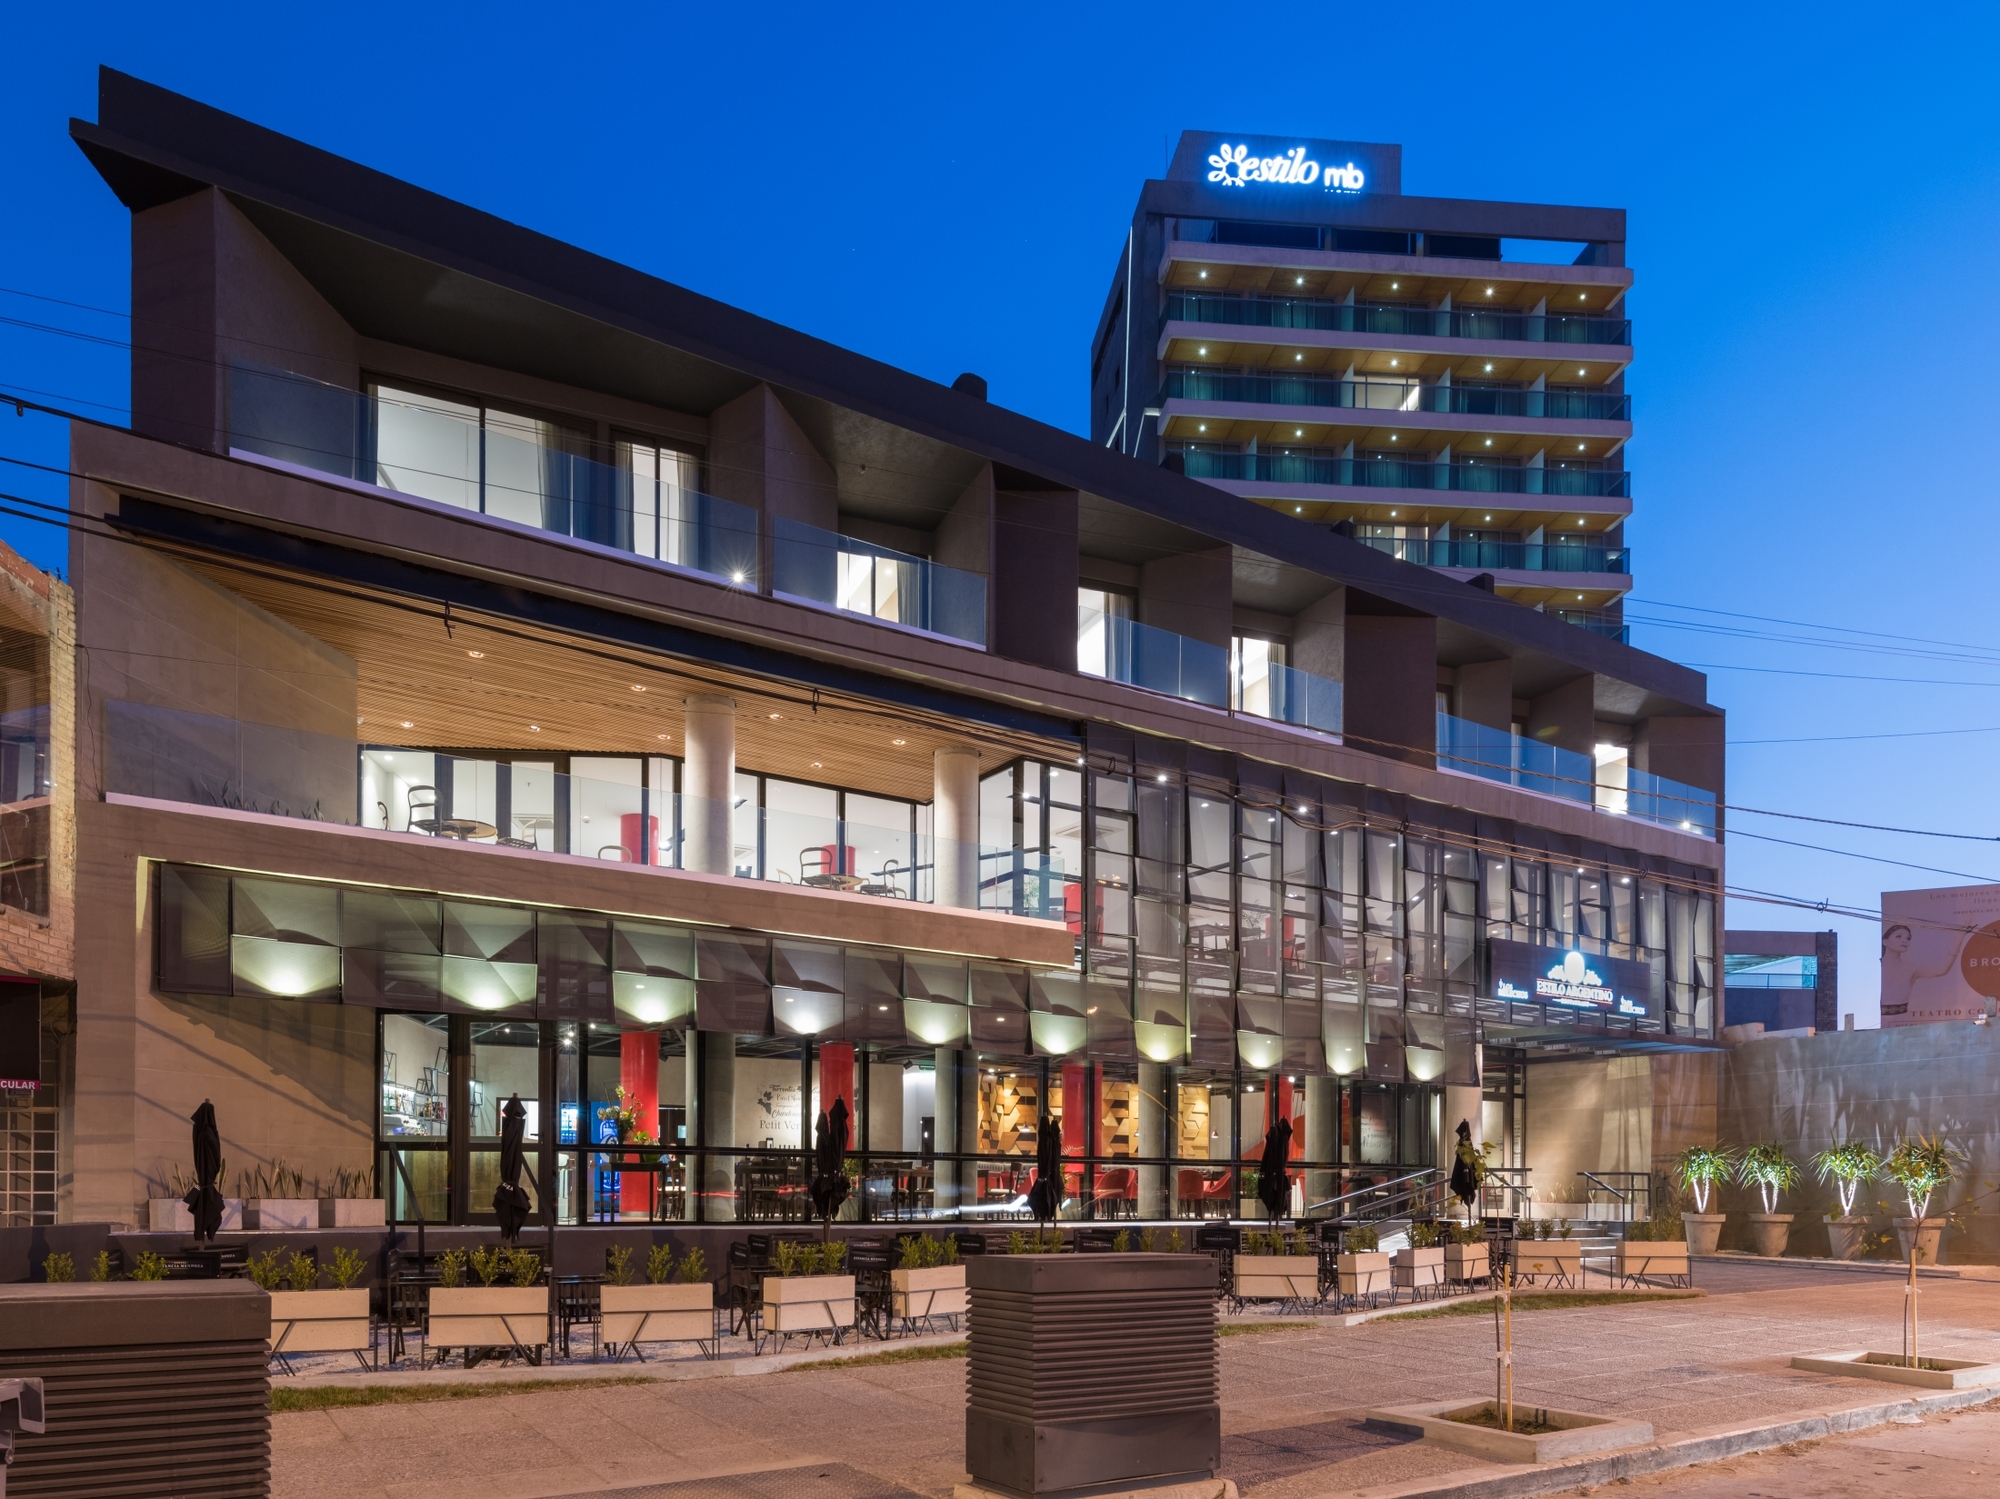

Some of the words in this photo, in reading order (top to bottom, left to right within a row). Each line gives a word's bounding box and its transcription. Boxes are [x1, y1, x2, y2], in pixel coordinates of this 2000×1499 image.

[1238, 147, 1319, 184] estilo
[1324, 162, 1364, 189] mb
[1536, 980, 1566, 995] ESTILO
[1566, 985, 1613, 1002] ARGENTINO
[1911, 1009, 1962, 1018] TEATRO
[0, 1080, 36, 1090] CULAR
[760, 1120, 781, 1130] Petit
